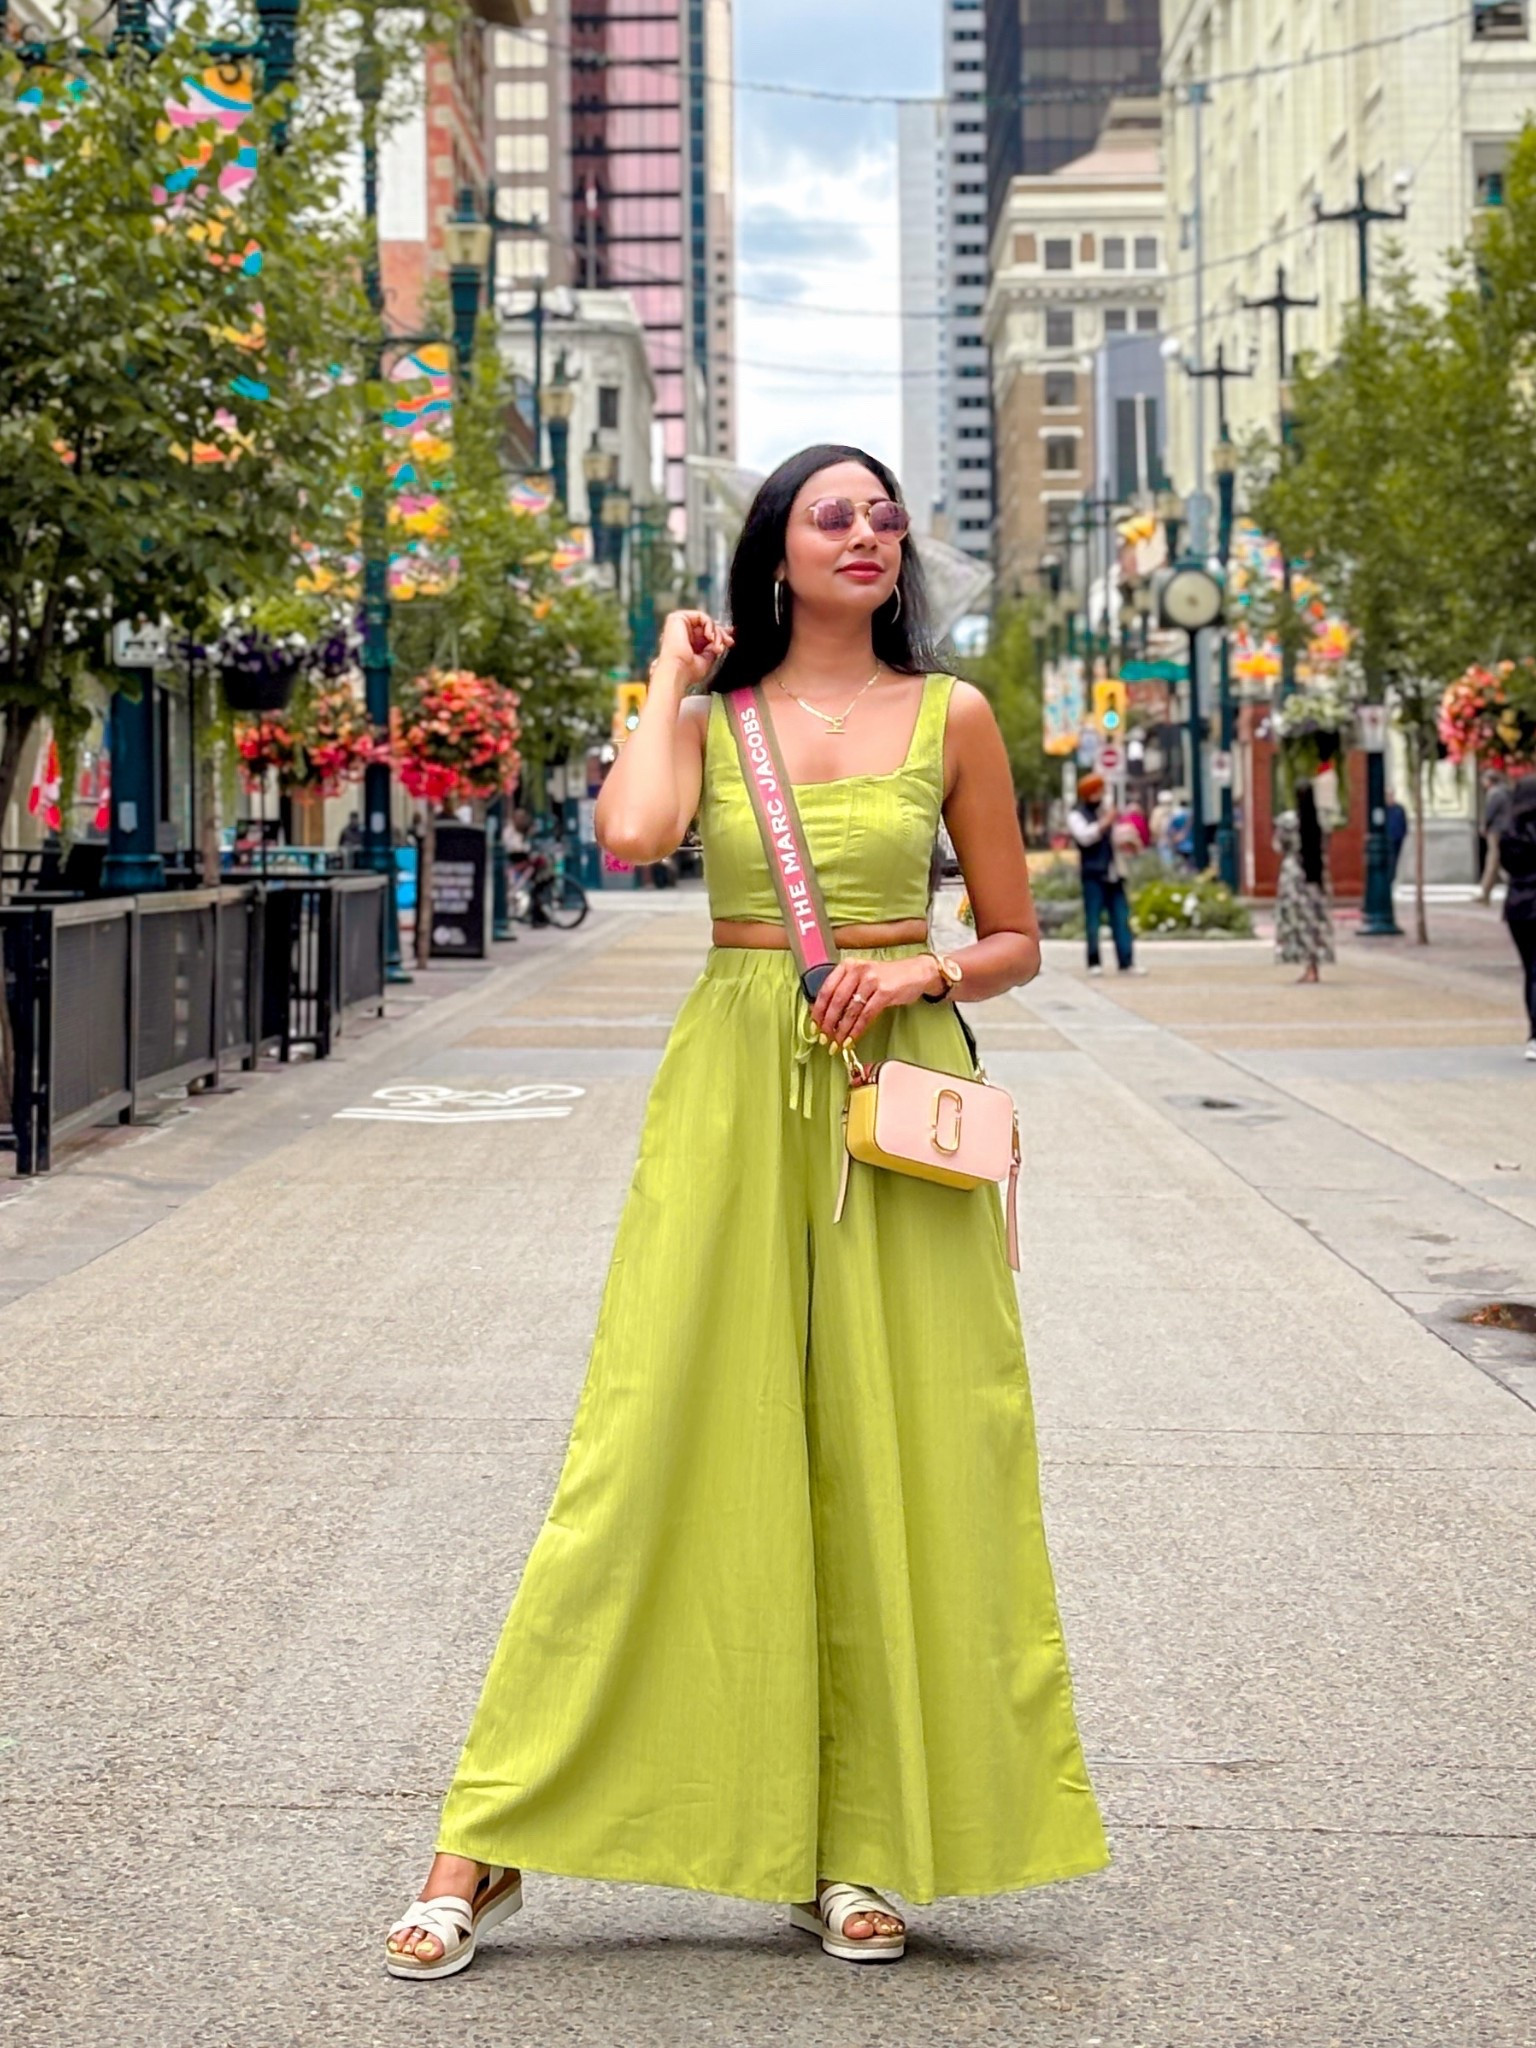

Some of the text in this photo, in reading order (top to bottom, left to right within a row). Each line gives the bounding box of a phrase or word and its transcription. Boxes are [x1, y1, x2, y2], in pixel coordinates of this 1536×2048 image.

[741, 707, 816, 936] THE MARC JACOBS
